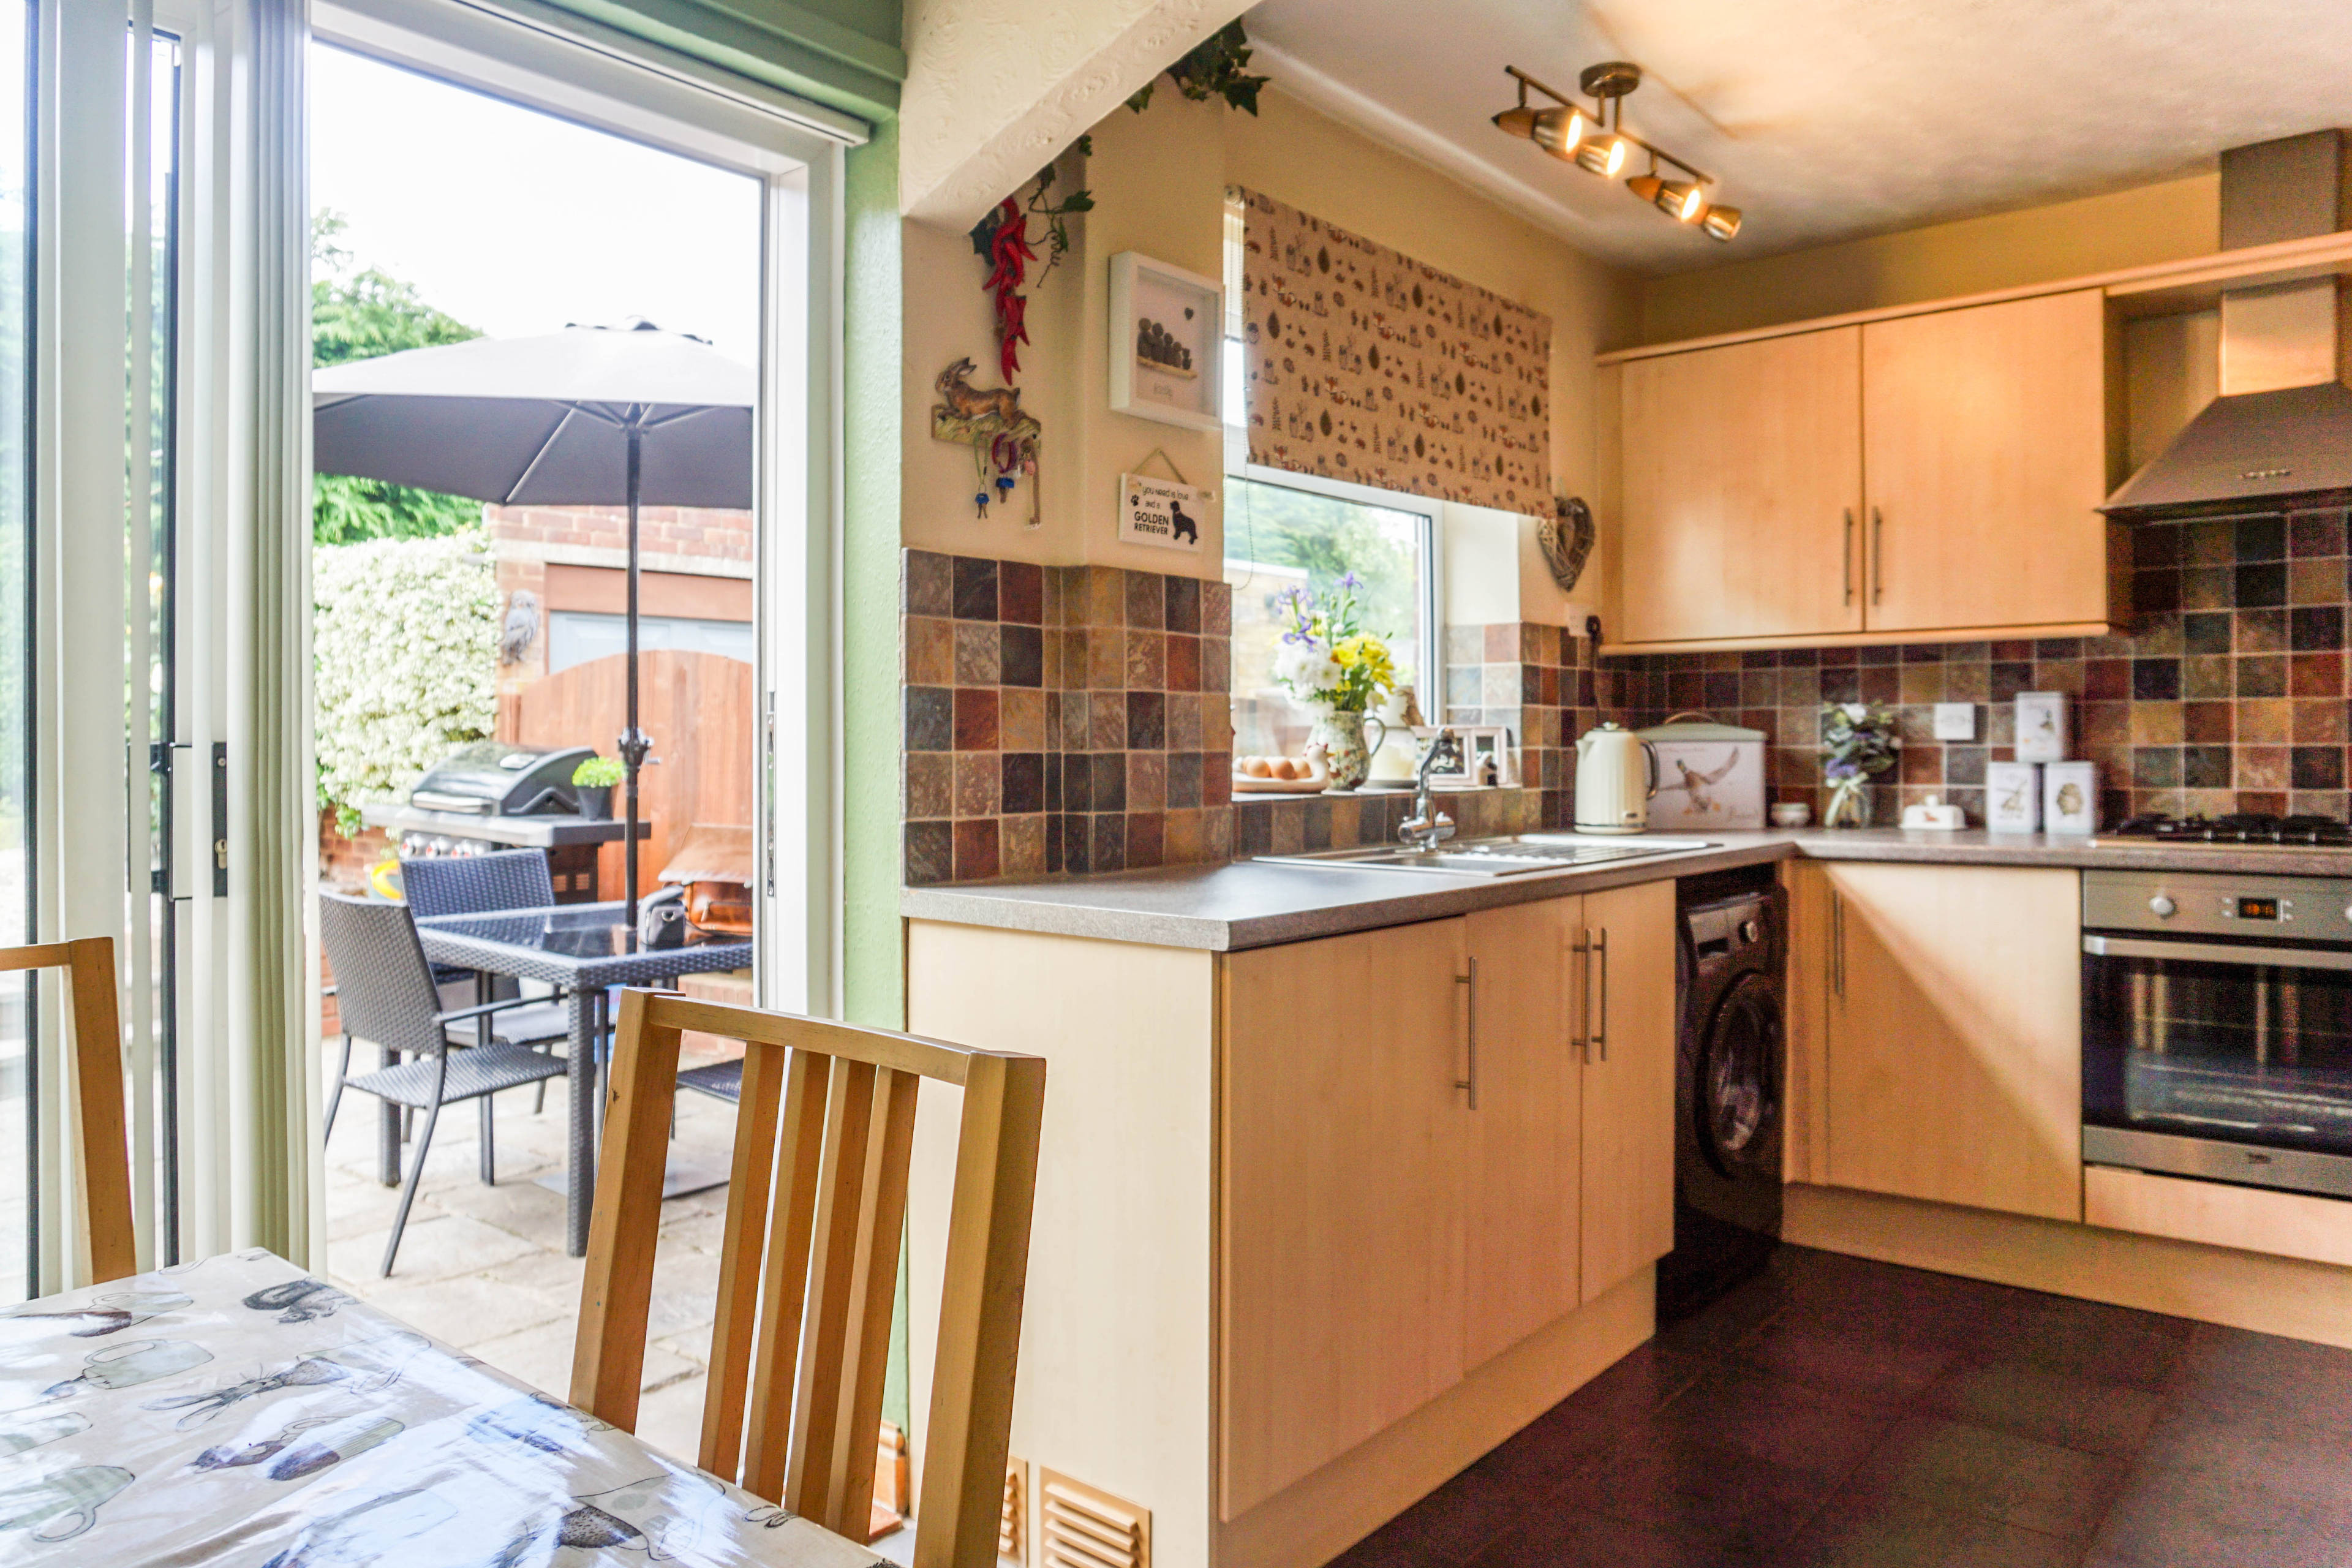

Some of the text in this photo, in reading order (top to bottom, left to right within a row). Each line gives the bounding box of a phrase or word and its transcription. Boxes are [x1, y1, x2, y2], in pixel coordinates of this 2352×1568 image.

[1143, 486, 1154, 496] you
[1134, 511, 1169, 526] GOLDEN
[1134, 523, 1168, 535] RETRIEVER
